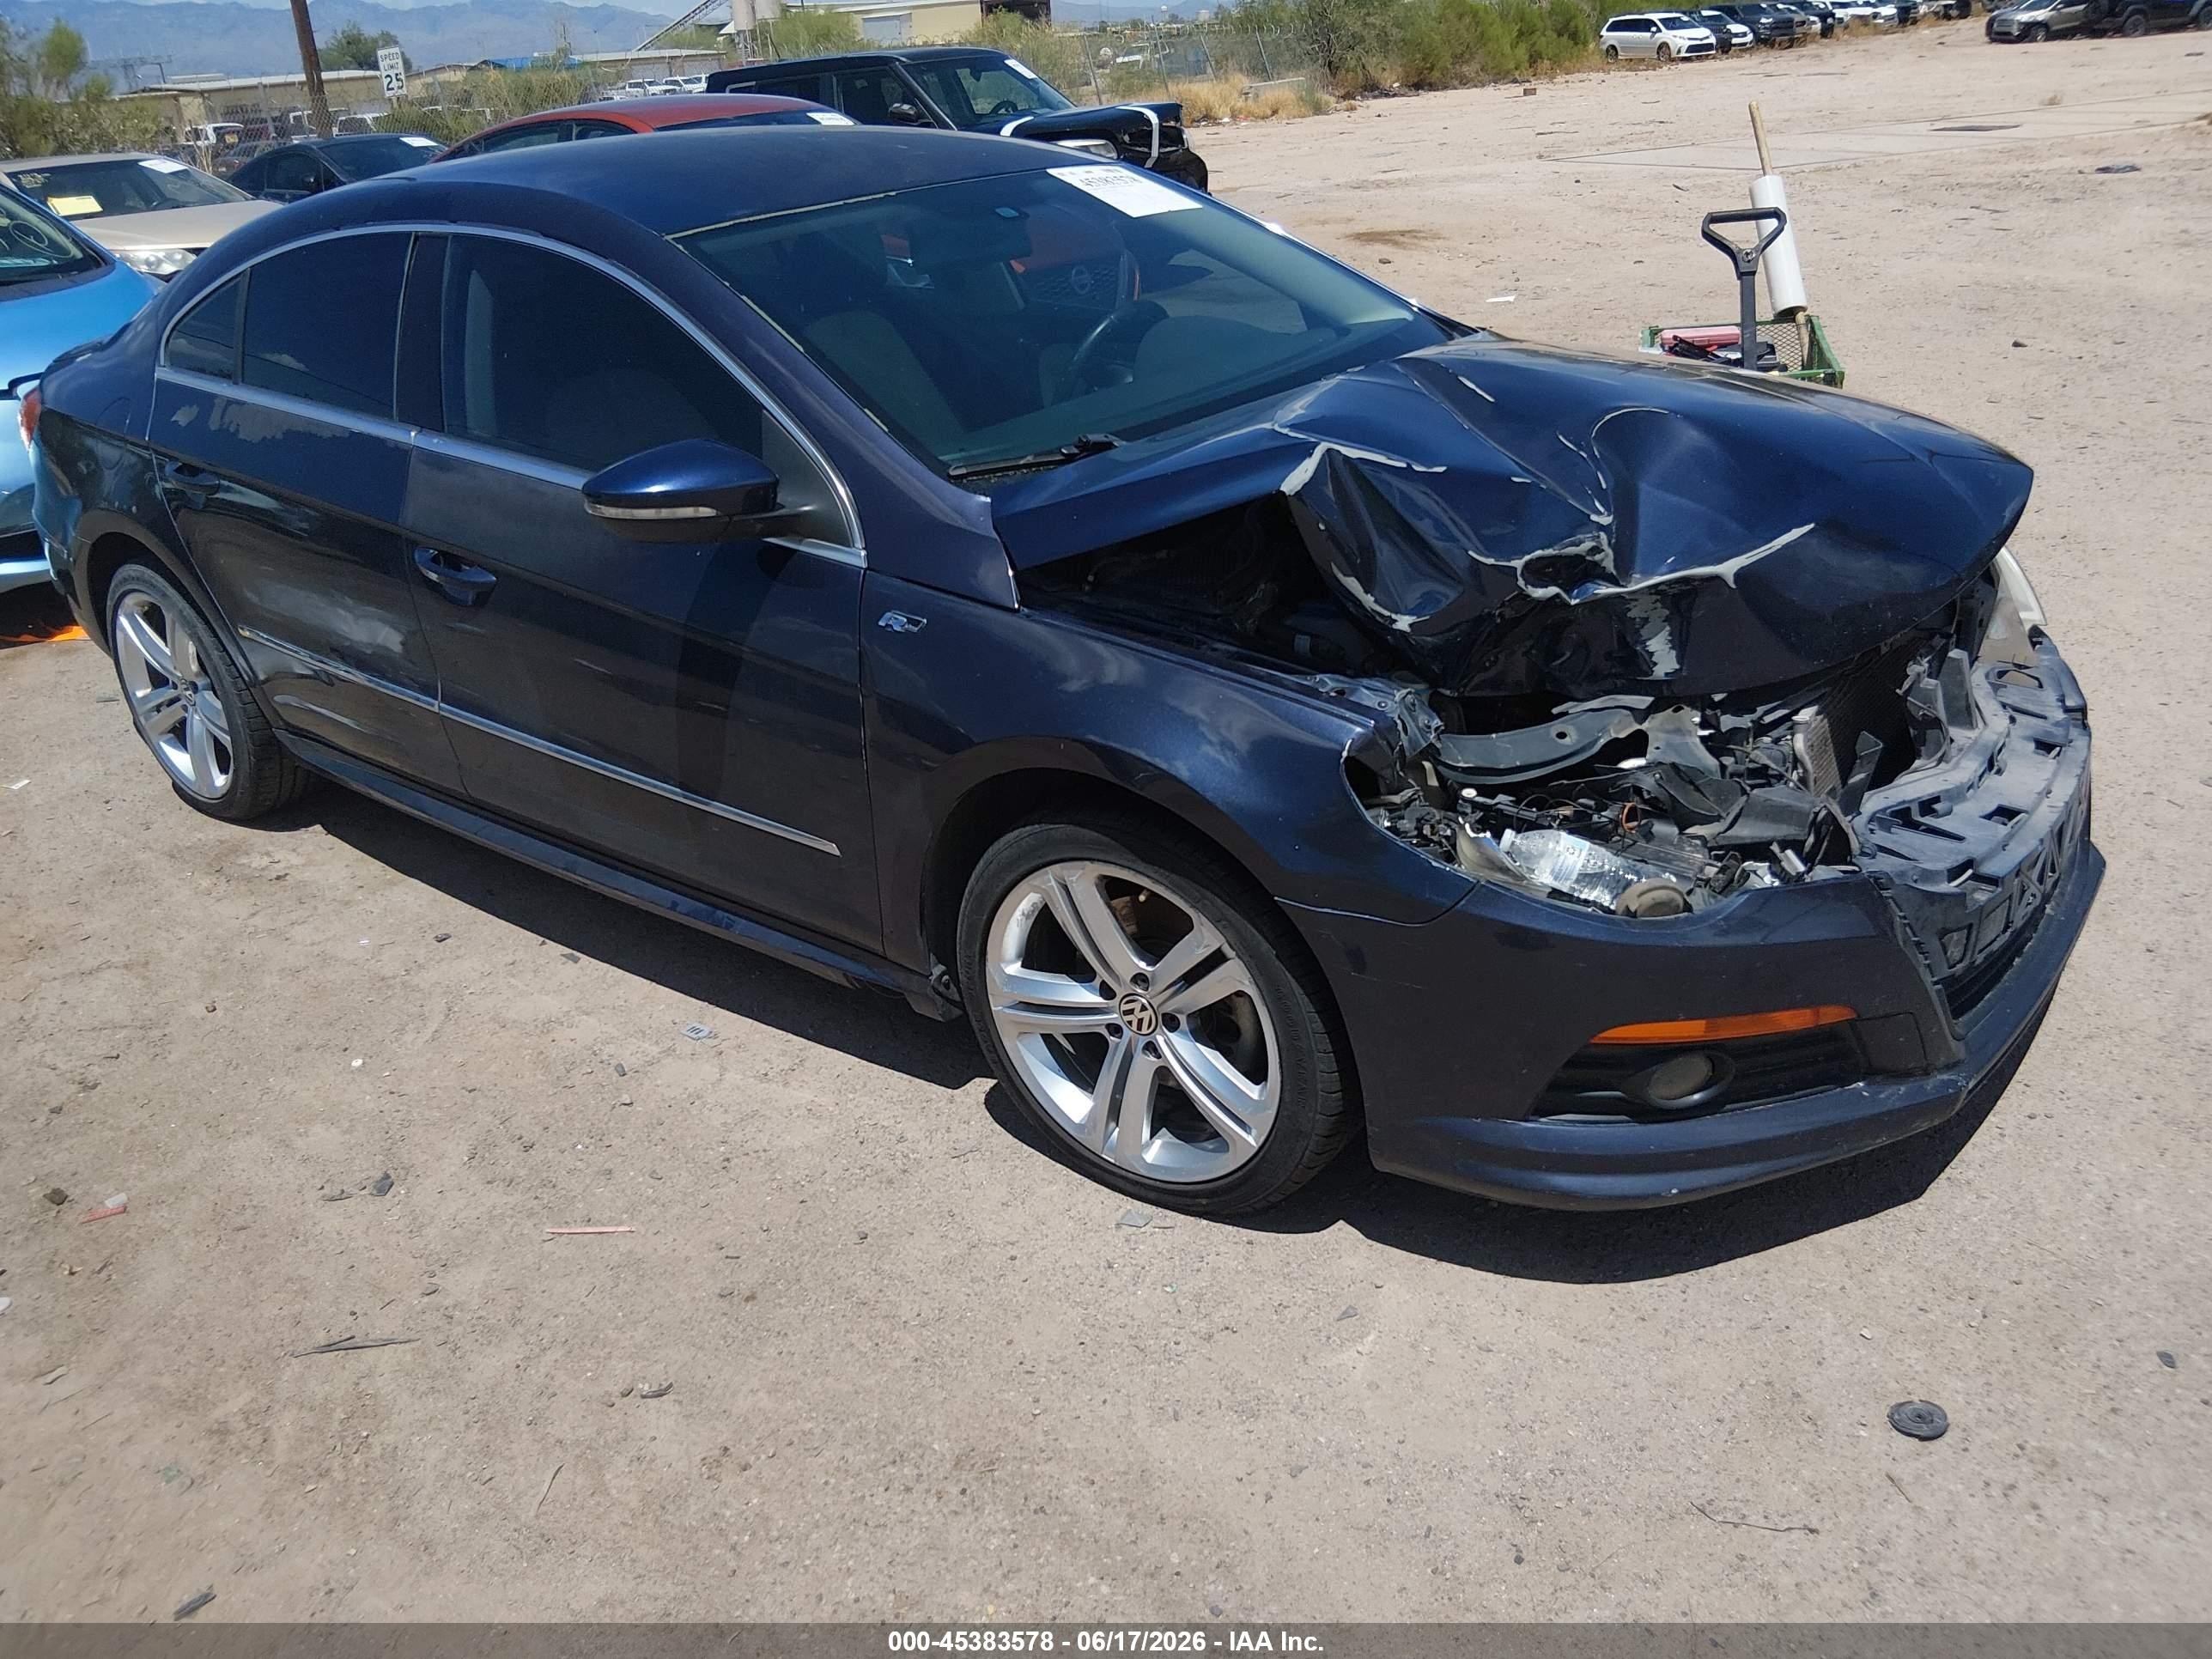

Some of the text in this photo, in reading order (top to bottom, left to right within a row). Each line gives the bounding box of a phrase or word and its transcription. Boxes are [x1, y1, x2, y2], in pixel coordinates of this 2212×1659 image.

[380, 52, 399, 63] SPEED
[383, 62, 399, 71] LIMIT
[384, 73, 404, 91] 25
